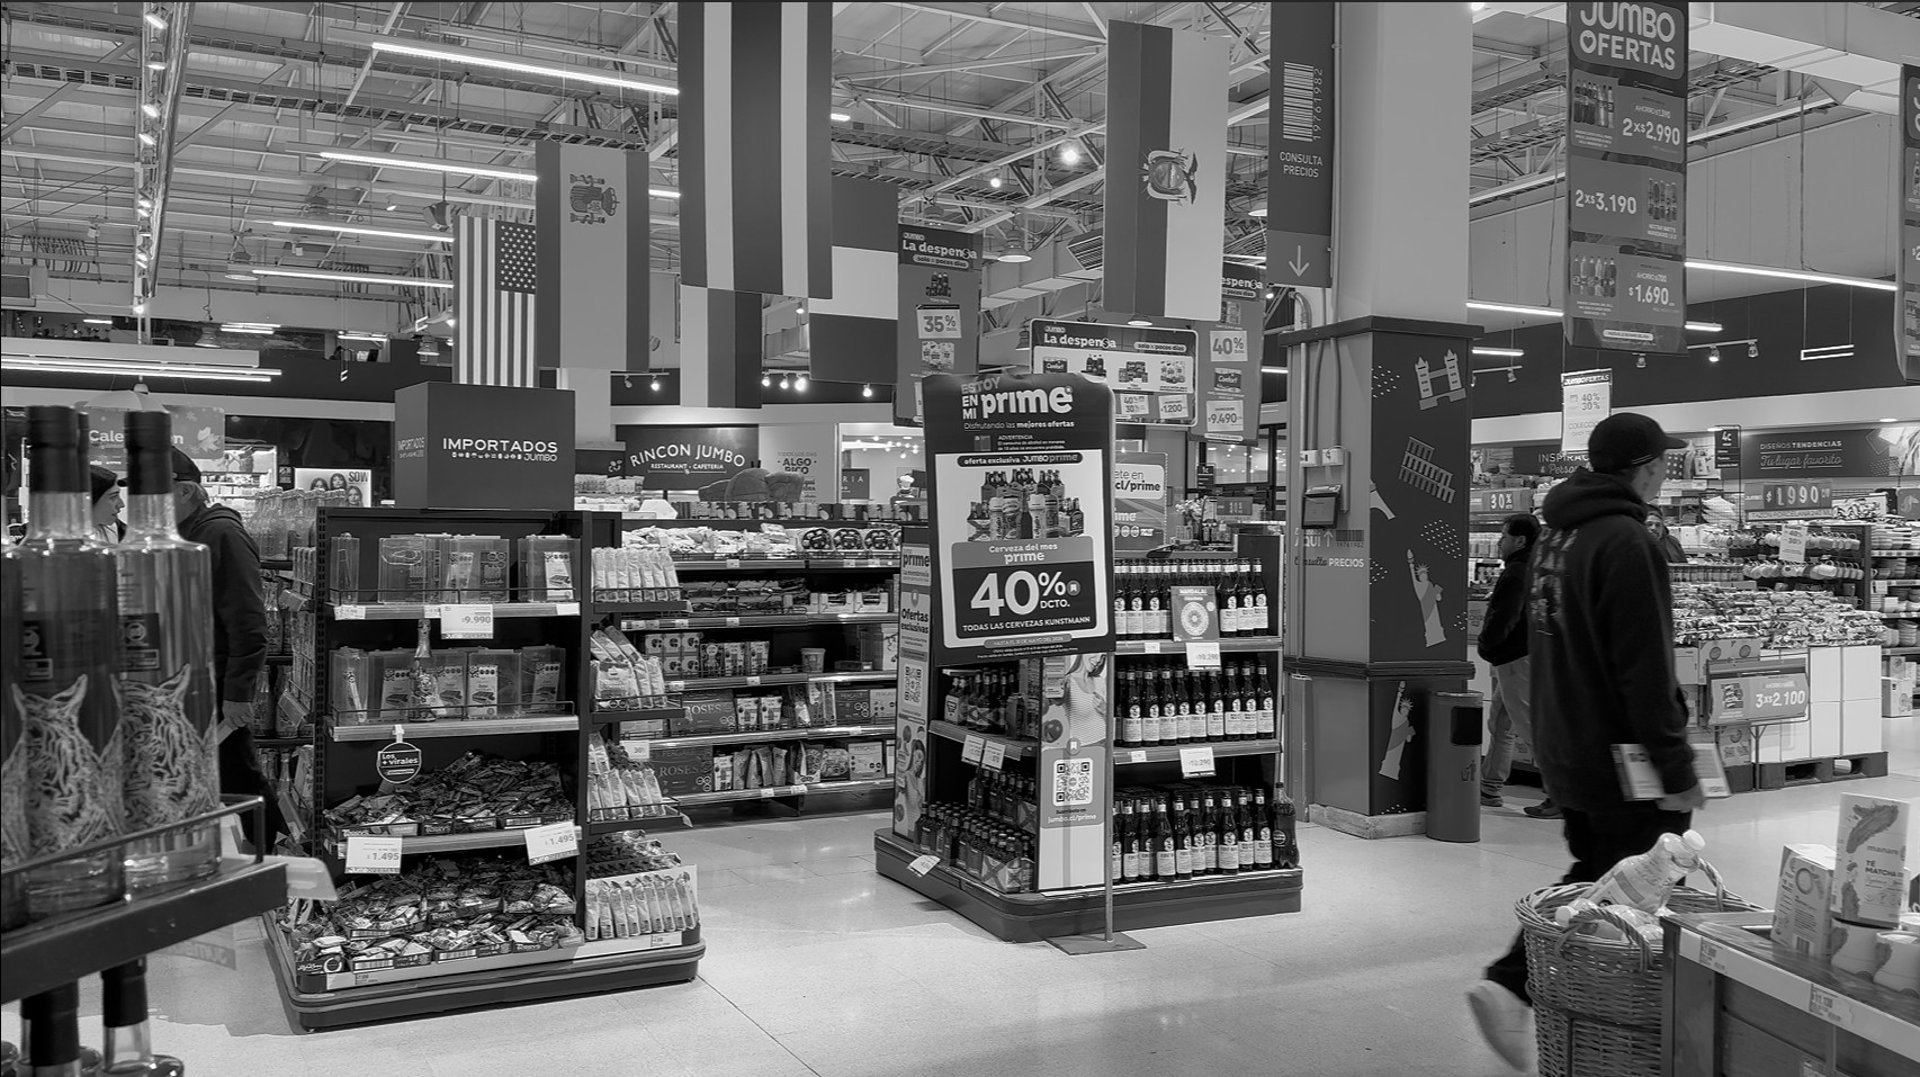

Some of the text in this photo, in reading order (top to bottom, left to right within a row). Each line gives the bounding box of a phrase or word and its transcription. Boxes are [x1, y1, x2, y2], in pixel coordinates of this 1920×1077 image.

[1579, 29, 1676, 71] OFERTAS
[1279, 151, 1323, 166] CONSULTA
[1283, 165, 1319, 178] PRECIOS
[902, 239, 918, 251] La
[1221, 276, 1264, 289] espensa
[1628, 284, 1669, 306] $1.690
[923, 314, 956, 332] 35%
[1044, 333, 1059, 344] La
[1213, 337, 1244, 355] 40%
[961, 377, 1000, 395] ESTOY
[962, 394, 979, 407] EN
[980, 386, 1073, 419] prime
[963, 408, 977, 420] MI
[964, 420, 1075, 431] Disfrutando las mejores ofertas
[442, 437, 558, 453] IMPORTADOS
[1792, 440, 1842, 448] TENDENCIAS
[630, 443, 746, 467] RINCON JUMBO
[988, 456, 1020, 465] exclusiva
[782, 457, 812, 467] ALGO
[1132, 470, 1144, 479] en
[988, 542, 1058, 553] Cerveza del mes
[903, 554, 930, 567] prime
[1004, 551, 1045, 564] prime
[1328, 557, 1365, 567] PRECIOS
[970, 570, 1067, 617] 40%
[1040, 599, 1071, 609] DCTO.
[901, 608, 928, 622] Ofertas
[901, 622, 928, 634] exclusivas
[962, 616, 1091, 632] TODAS LAS CERVEZAS KUNSTMANN
[388, 757, 418, 765] virales
[660, 765, 699, 776] ROSES
[1864, 867, 1897, 877] MATCHA
